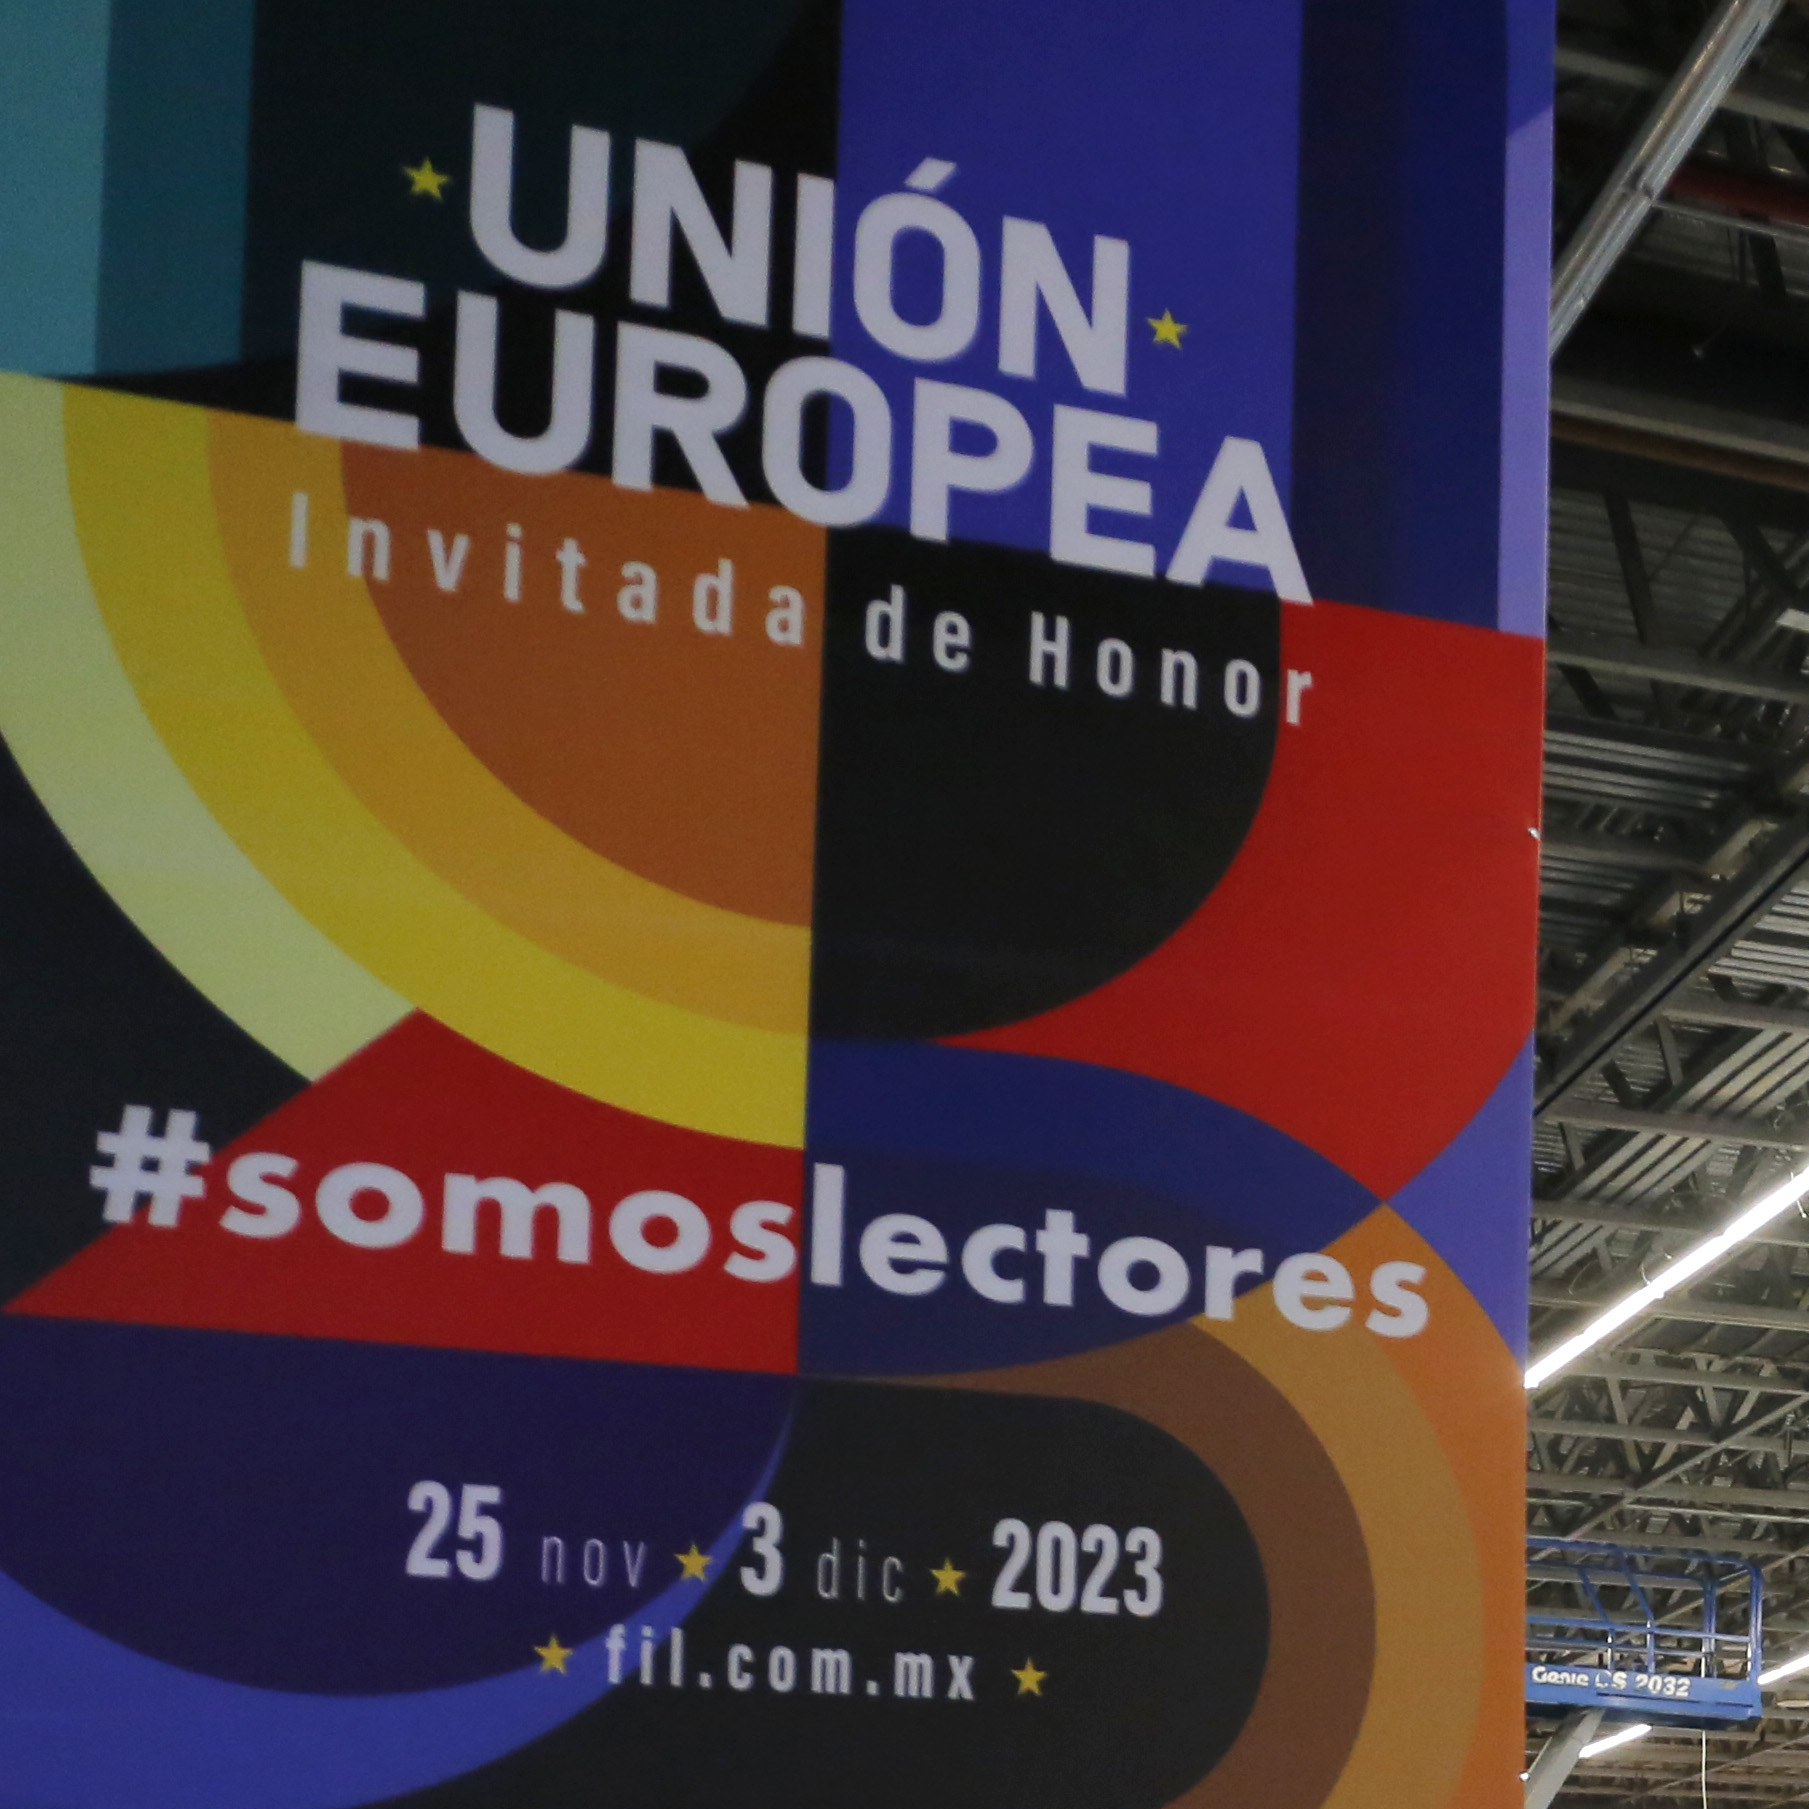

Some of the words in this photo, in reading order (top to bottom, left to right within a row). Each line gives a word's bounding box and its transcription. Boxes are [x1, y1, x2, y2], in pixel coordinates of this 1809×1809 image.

[469, 102, 1131, 396] UNIÓN
[295, 258, 1314, 606] EUROPEA
[288, 491, 806, 646] Invitada
[865, 585, 973, 673] de
[1030, 612, 1314, 727] Honor
[89, 1102, 1429, 1340] #somoslectores
[404, 1479, 503, 1580] 25
[540, 1530, 646, 1589] nov
[738, 1497, 783, 1597] 3
[815, 1534, 905, 1603] dic
[992, 1517, 1164, 1619] 2023
[605, 1622, 977, 1703] fil.com.mx
[1532, 1666, 1590, 1688] Genie
[1635, 1674, 1691, 1698] 2032
